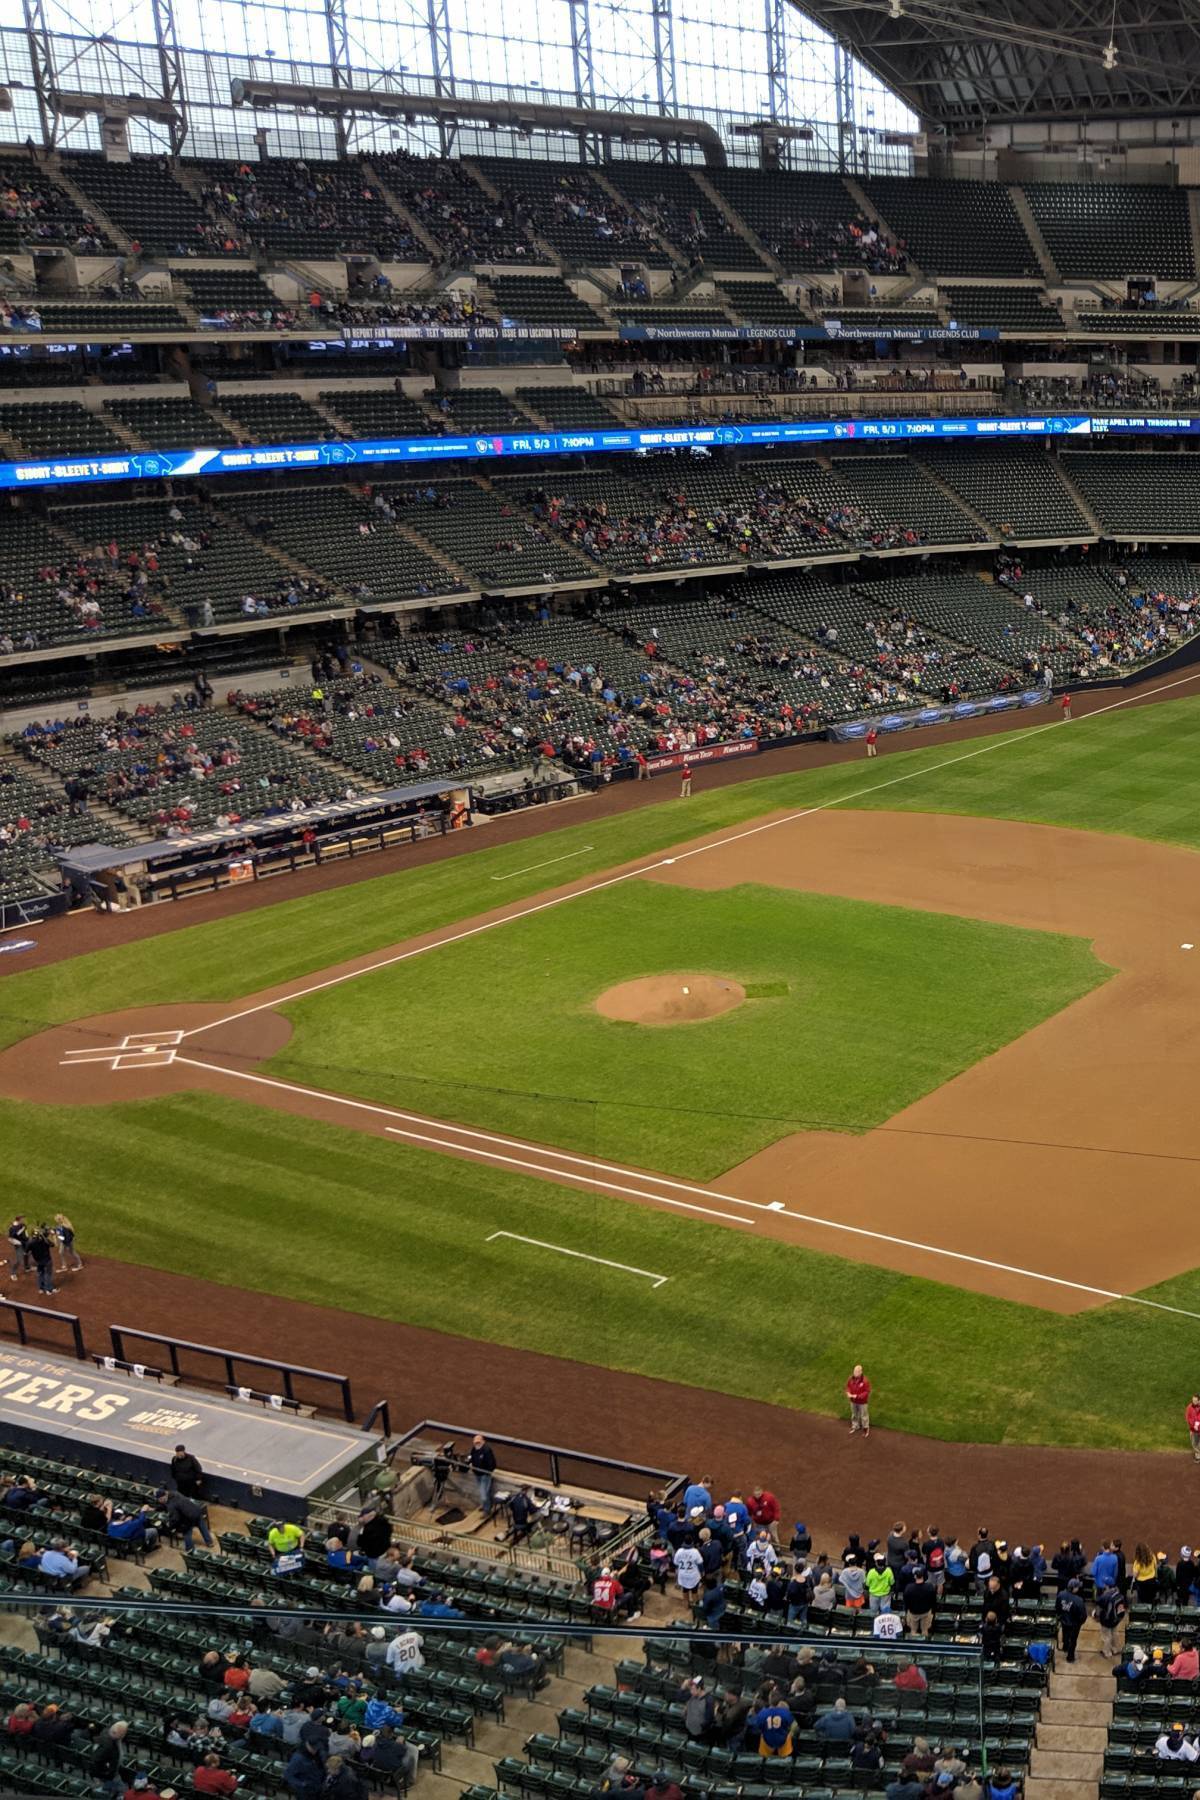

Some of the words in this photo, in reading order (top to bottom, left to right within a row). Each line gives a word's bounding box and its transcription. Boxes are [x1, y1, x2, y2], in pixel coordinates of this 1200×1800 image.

[657, 329, 710, 338] Northwestern
[746, 330, 777, 338] LEGENDS
[778, 330, 796, 338] CLUB
[838, 329, 892, 339] Northwestern
[928, 330, 960, 338] LEGENDS
[961, 330, 979, 338] CLUB
[534, 439, 550, 449] 5/3
[17, 1358, 41, 1368] OF
[40, 1363, 72, 1376] THE
[880, 1624, 894, 1636] 46
[400, 1646, 416, 1662] 20
[766, 1715, 782, 1729] 19
